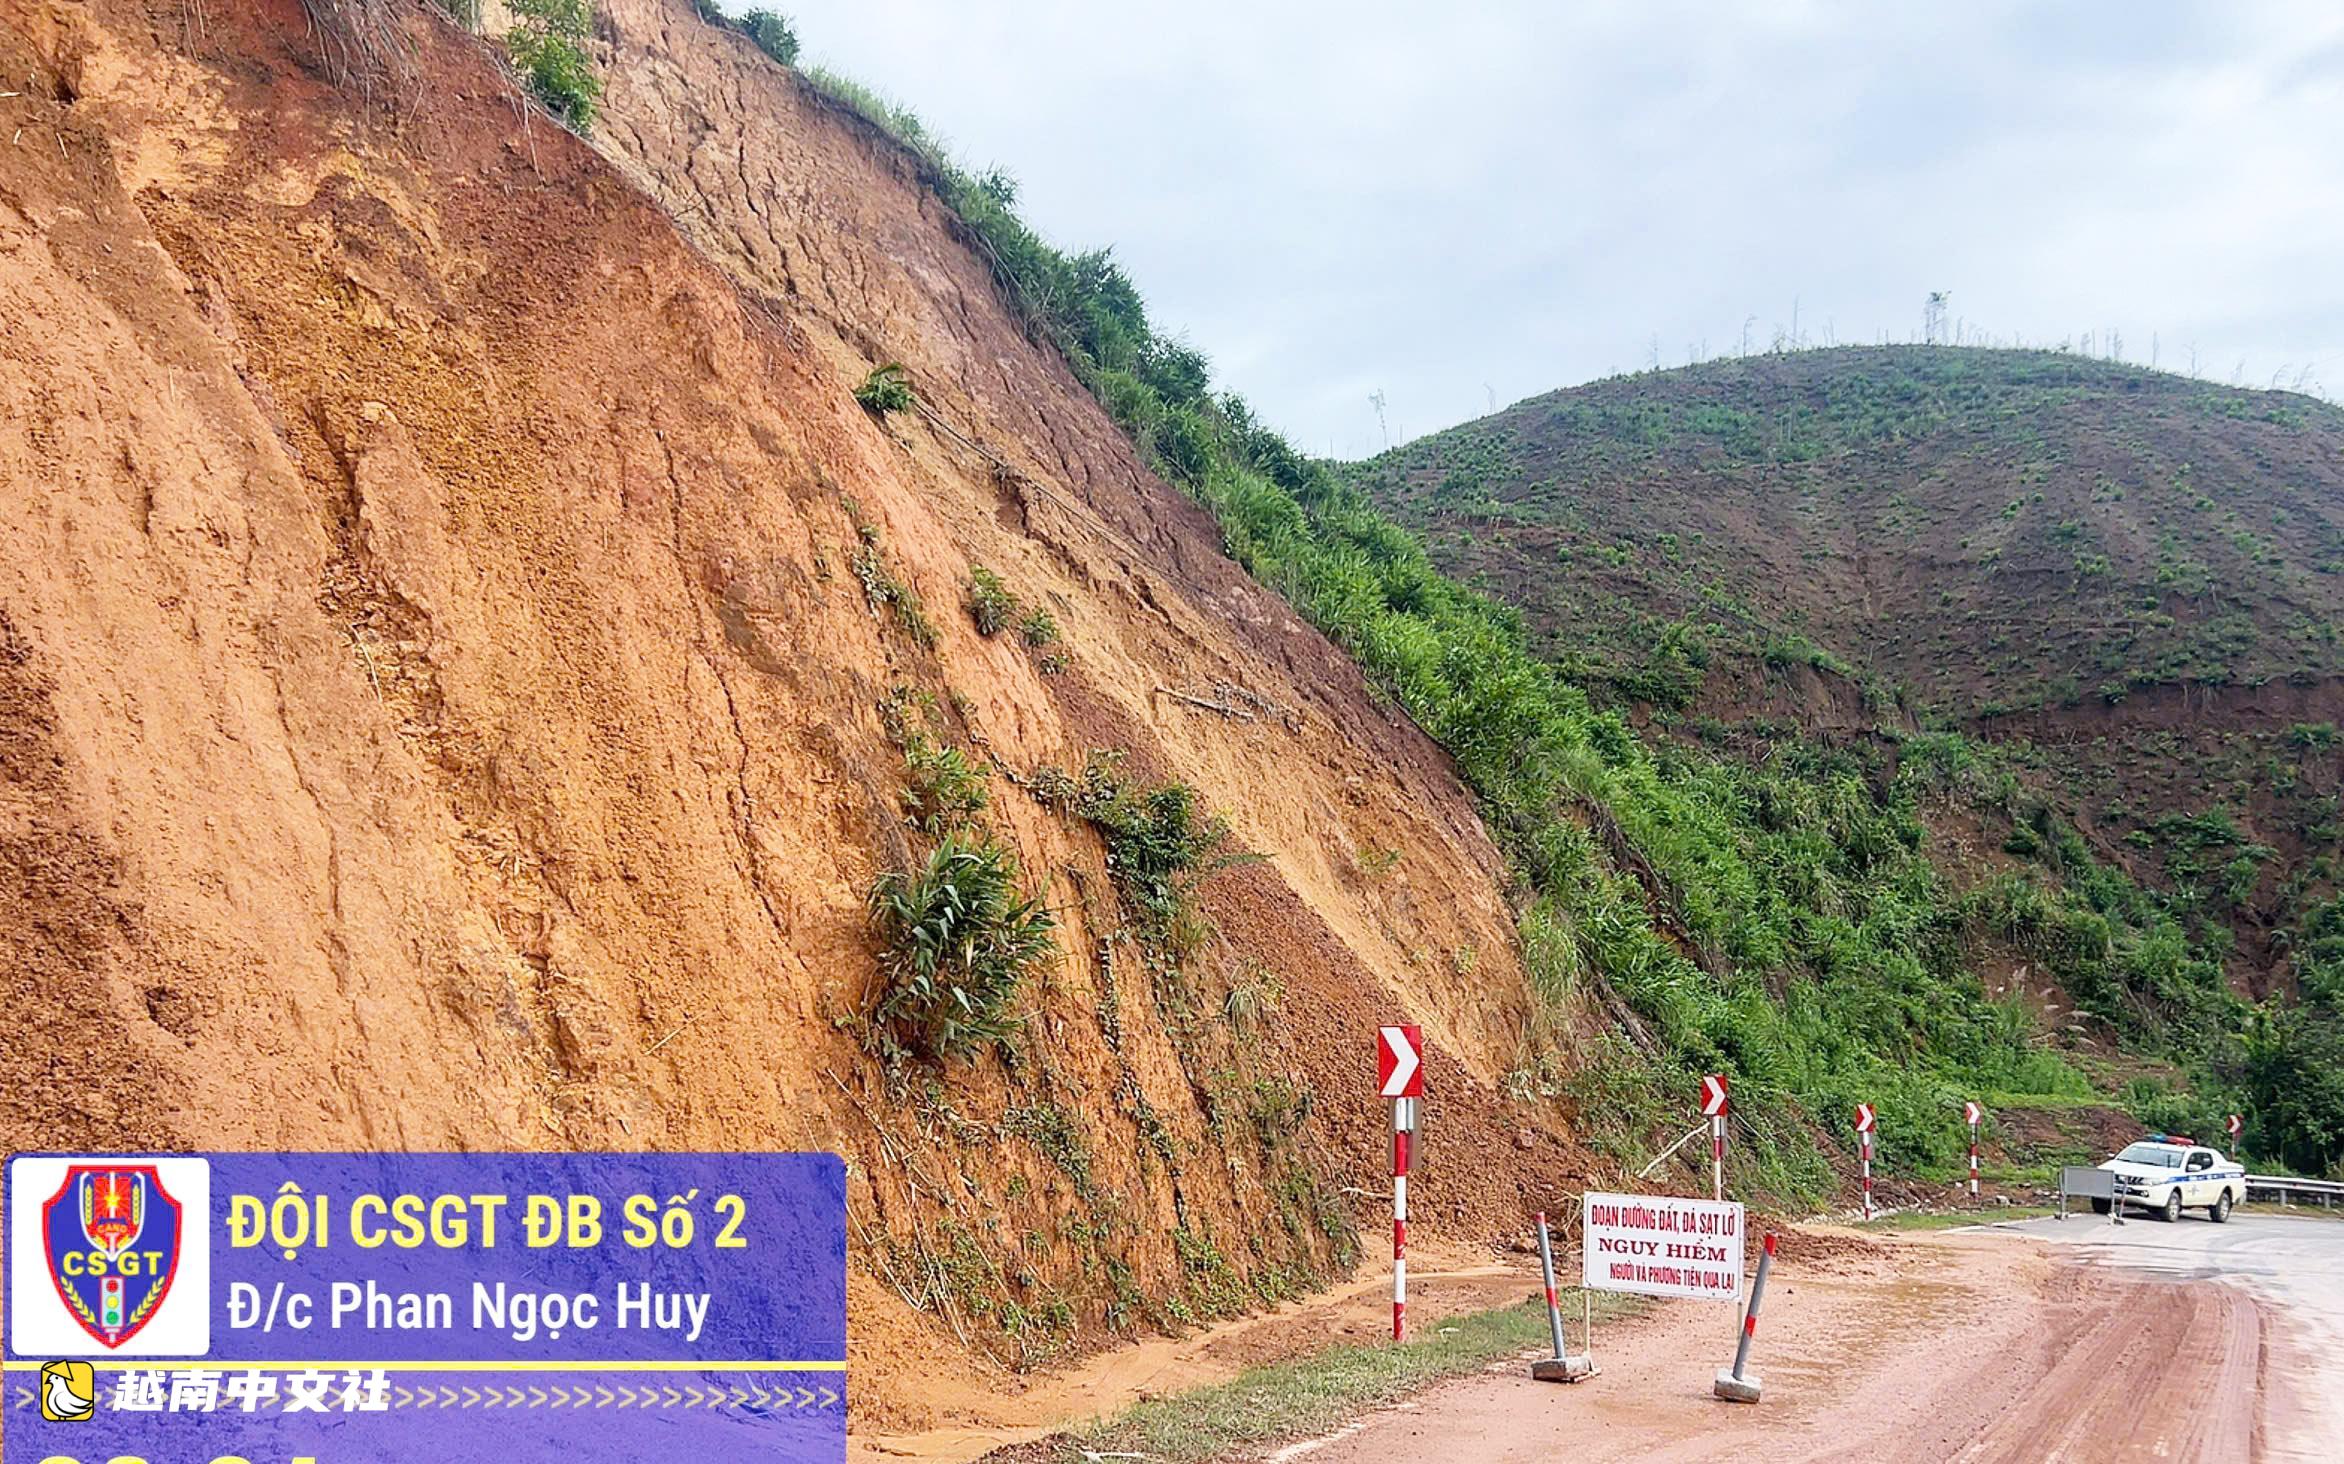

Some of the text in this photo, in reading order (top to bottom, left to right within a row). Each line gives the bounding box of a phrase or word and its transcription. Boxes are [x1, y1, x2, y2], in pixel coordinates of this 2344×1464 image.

[1700, 1212, 1719, 1239] SẠT
[1598, 1237, 1727, 1263] NGUY HIỂM
[1703, 1271, 1720, 1290] QUA
